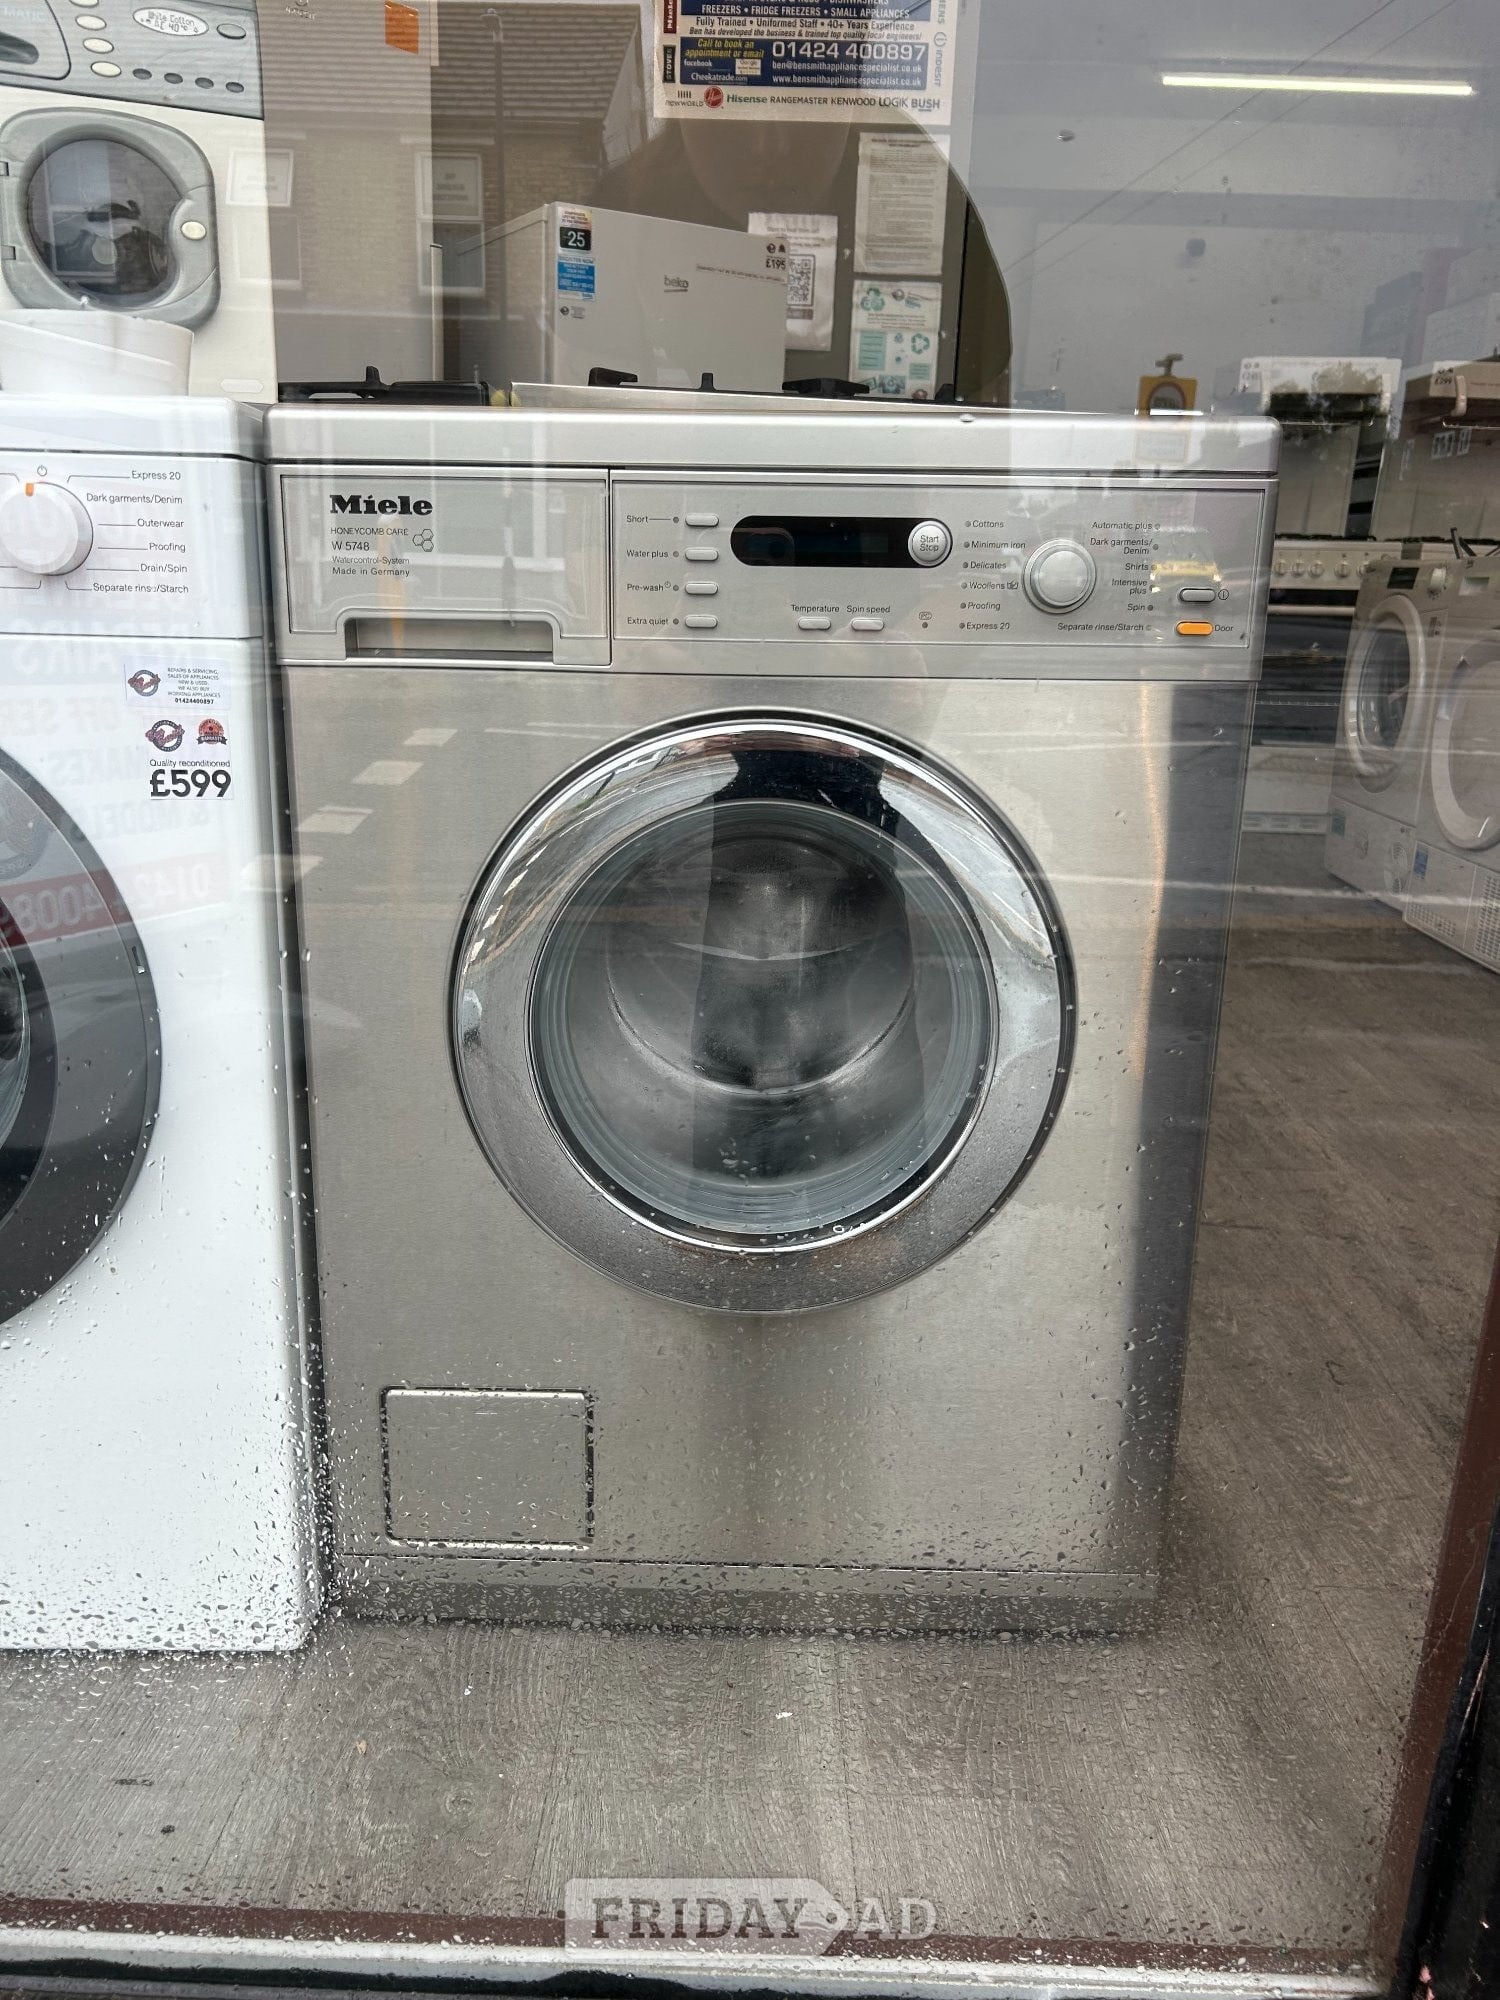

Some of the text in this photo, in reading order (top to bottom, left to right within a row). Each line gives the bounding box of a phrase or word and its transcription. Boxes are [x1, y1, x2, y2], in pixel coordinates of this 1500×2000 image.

[701, 4, 910, 19] FREEZERS FRIDGE FREEZERS SMALL APPLIANCES
[696, 16, 915, 31] Fully Trained Uniformed Staff 40+ Years Experience
[689, 27, 702, 35] Ben
[704, 27, 716, 36] has
[717, 27, 752, 37] developed
[754, 28, 764, 37] the
[766, 28, 796, 38] business
[797, 29, 803, 38] &
[804, 29, 829, 39] trained
[830, 31, 842, 39] top
[842, 31, 867, 40] quality
[867, 31, 885, 41] local
[698, 38, 755, 49] Call to book an
[685, 47, 765, 59] appointment or email
[772, 40, 926, 61] 01424 400897
[684, 59, 713, 68] facebook
[772, 59, 922, 73] ben@bensmithappliancespecialist.co.uk
[772, 74, 922, 87] www.bensmithappliancespecialist.co.uk
[727, 93, 941, 111] Hisense RANGEMASTER KENWOOD LOGIK BUSH
[567, 230, 586, 248] 25
[765, 258, 787, 271] £195
[664, 275, 689, 289] beko
[131, 470, 182, 481] Express 20
[86, 493, 183, 505] Dark garments/Denim
[329, 494, 434, 516] Miele
[137, 518, 185, 529] Outerwear
[626, 514, 649, 524] Short
[972, 519, 1005, 529] Cottons
[330, 527, 409, 536] HONEYCOMB CARE
[1091, 521, 1153, 532] Automatic plus
[919, 533, 940, 544] Start
[1089, 537, 1153, 549] Dark garments/
[148, 542, 187, 554] Proofing
[331, 541, 370, 551] W 5748
[919, 543, 940, 553] Stop
[971, 540, 1026, 550] Minimum iron
[626, 549, 669, 560] Water plus
[1123, 547, 1150, 556] Denim
[140, 563, 188, 574] Drain/Spin
[970, 560, 1007, 570] Delicates
[1125, 562, 1149, 572] Shirts
[332, 566, 410, 578] Made in Germany
[92, 581, 133, 594] Separate
[626, 583, 664, 593] Pre-wash
[969, 580, 1005, 590] Woollens
[1111, 578, 1148, 588] Intensive
[1129, 586, 1147, 596] plus
[791, 604, 840, 614] Temperature
[846, 604, 891, 615] Spin speed
[967, 601, 1001, 611] Proofing
[1127, 603, 1146, 614] Spin
[627, 616, 669, 627] Extra quiet
[966, 621, 998, 632] Express
[1057, 622, 1093, 633] Separate
[1214, 624, 1234, 633] Door
[149, 758, 231, 768] Quality reconditioned
[149, 768, 232, 798] £599
